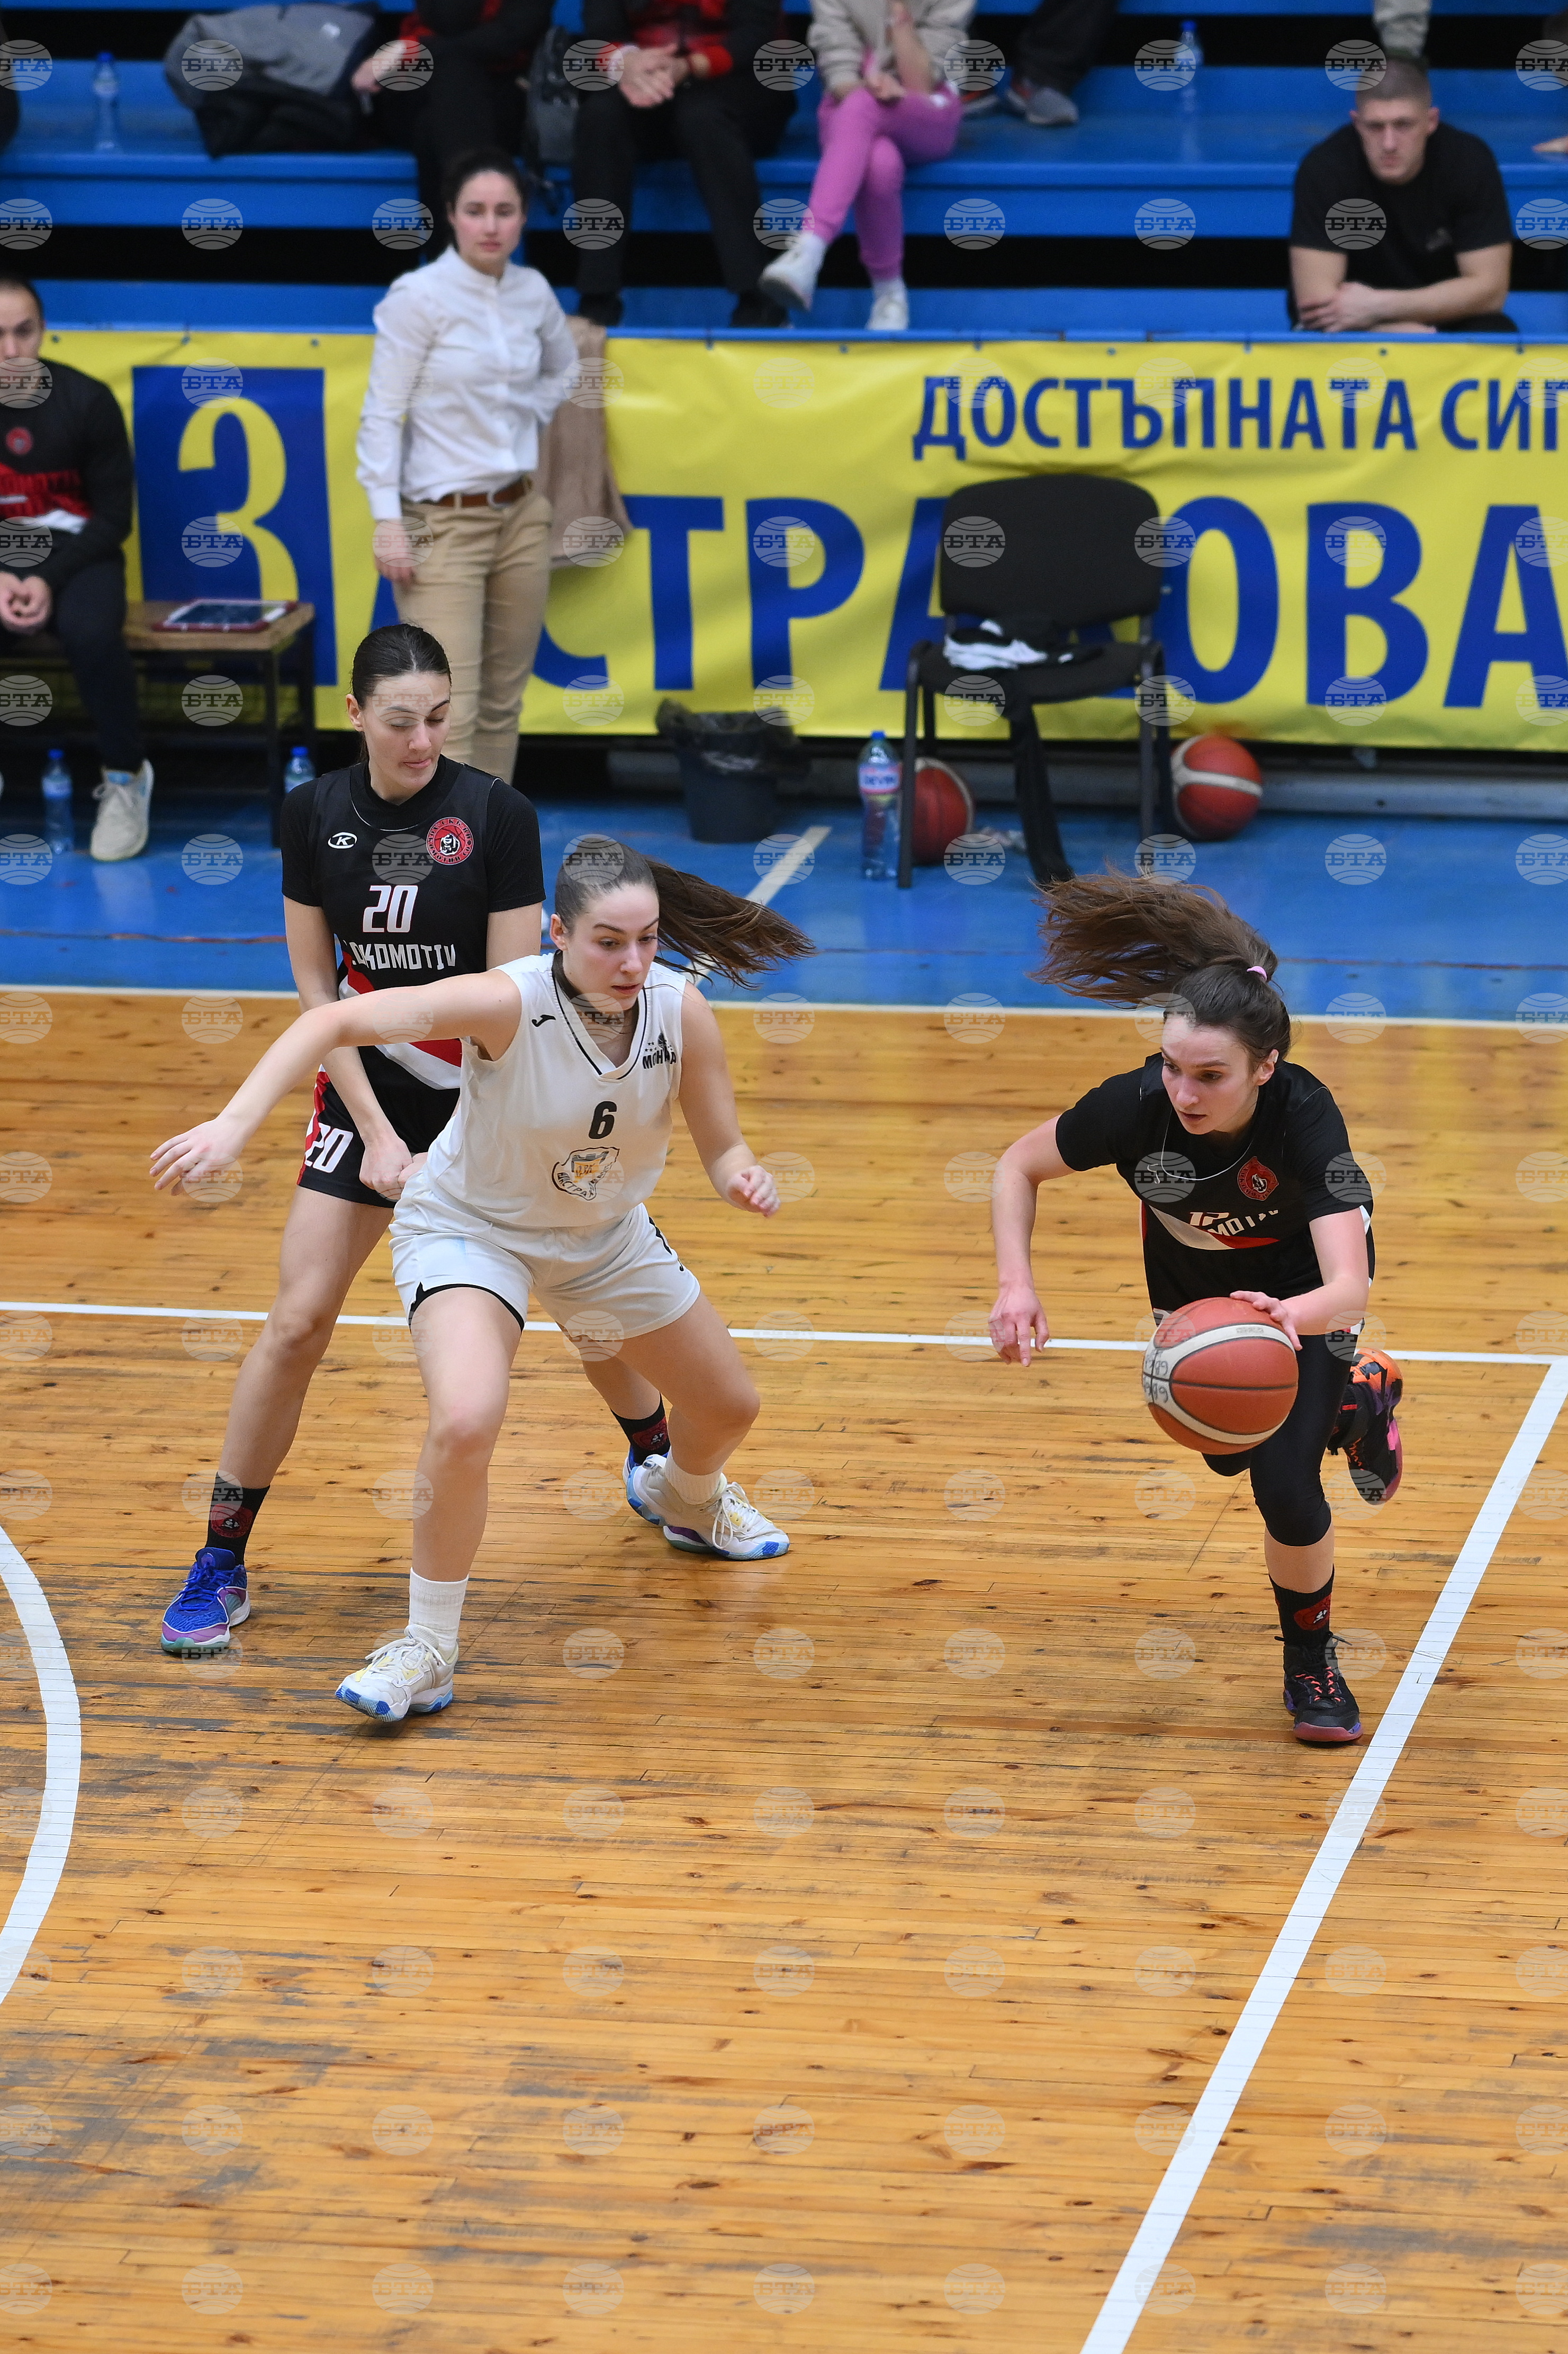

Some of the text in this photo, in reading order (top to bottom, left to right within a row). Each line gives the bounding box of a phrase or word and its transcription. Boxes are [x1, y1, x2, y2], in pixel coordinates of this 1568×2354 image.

[912, 376, 1417, 461] ДОСТЪПНАТА
[363, 885, 419, 933] 20
[343, 940, 456, 970] OKOMOTIV
[588, 1101, 617, 1139] 6
[304, 1122, 354, 1173] 20
